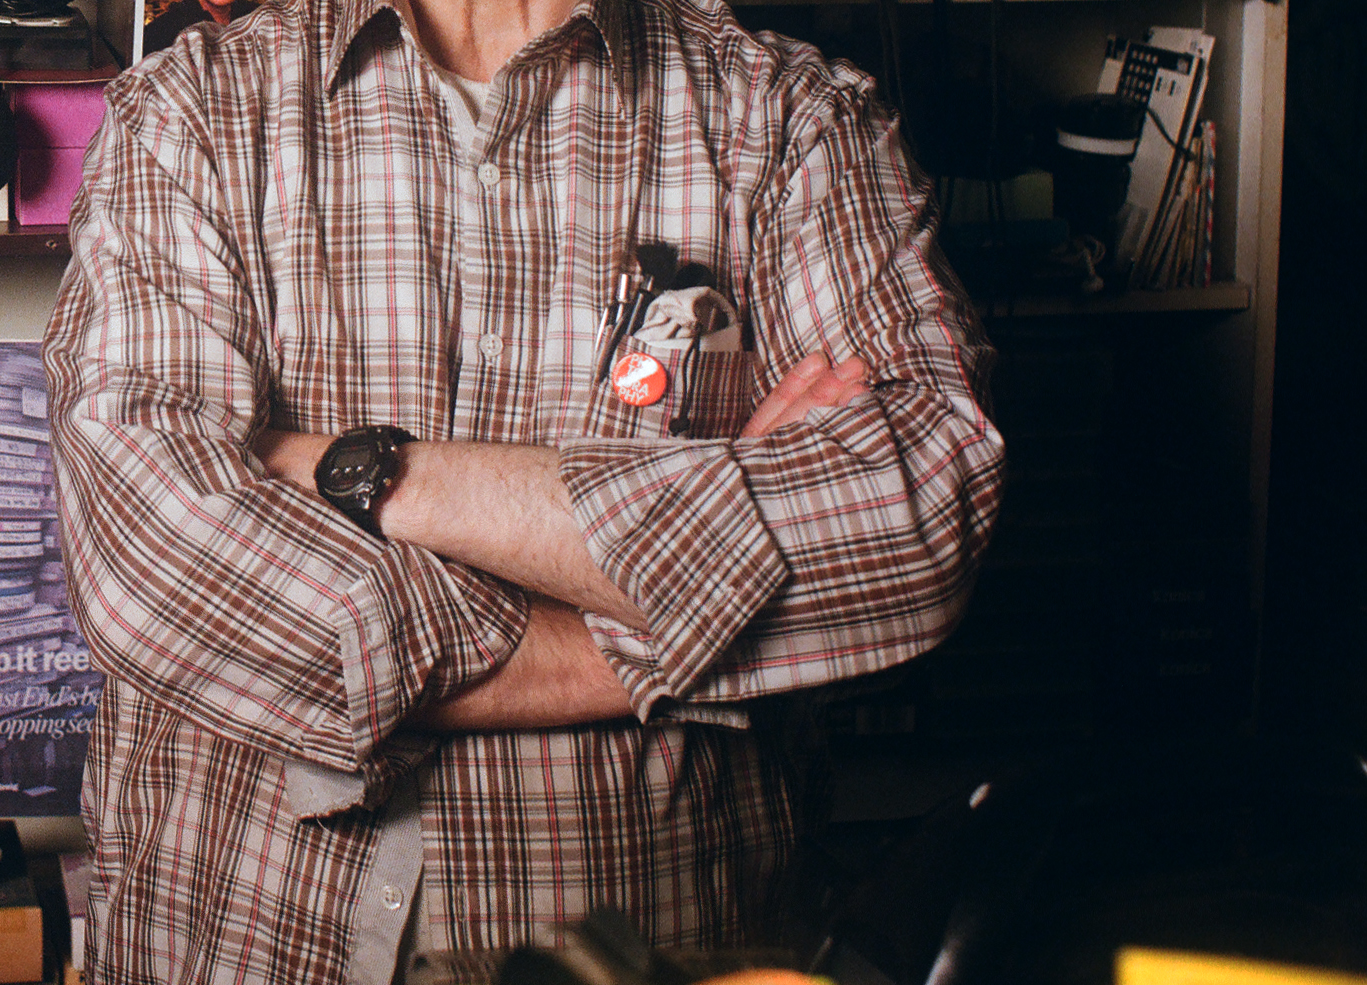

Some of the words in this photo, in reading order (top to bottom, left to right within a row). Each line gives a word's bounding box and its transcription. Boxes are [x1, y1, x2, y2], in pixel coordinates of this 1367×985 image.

[16, 647, 37, 673] it
[42, 651, 96, 672] ree
[22, 685, 77, 707] End's
